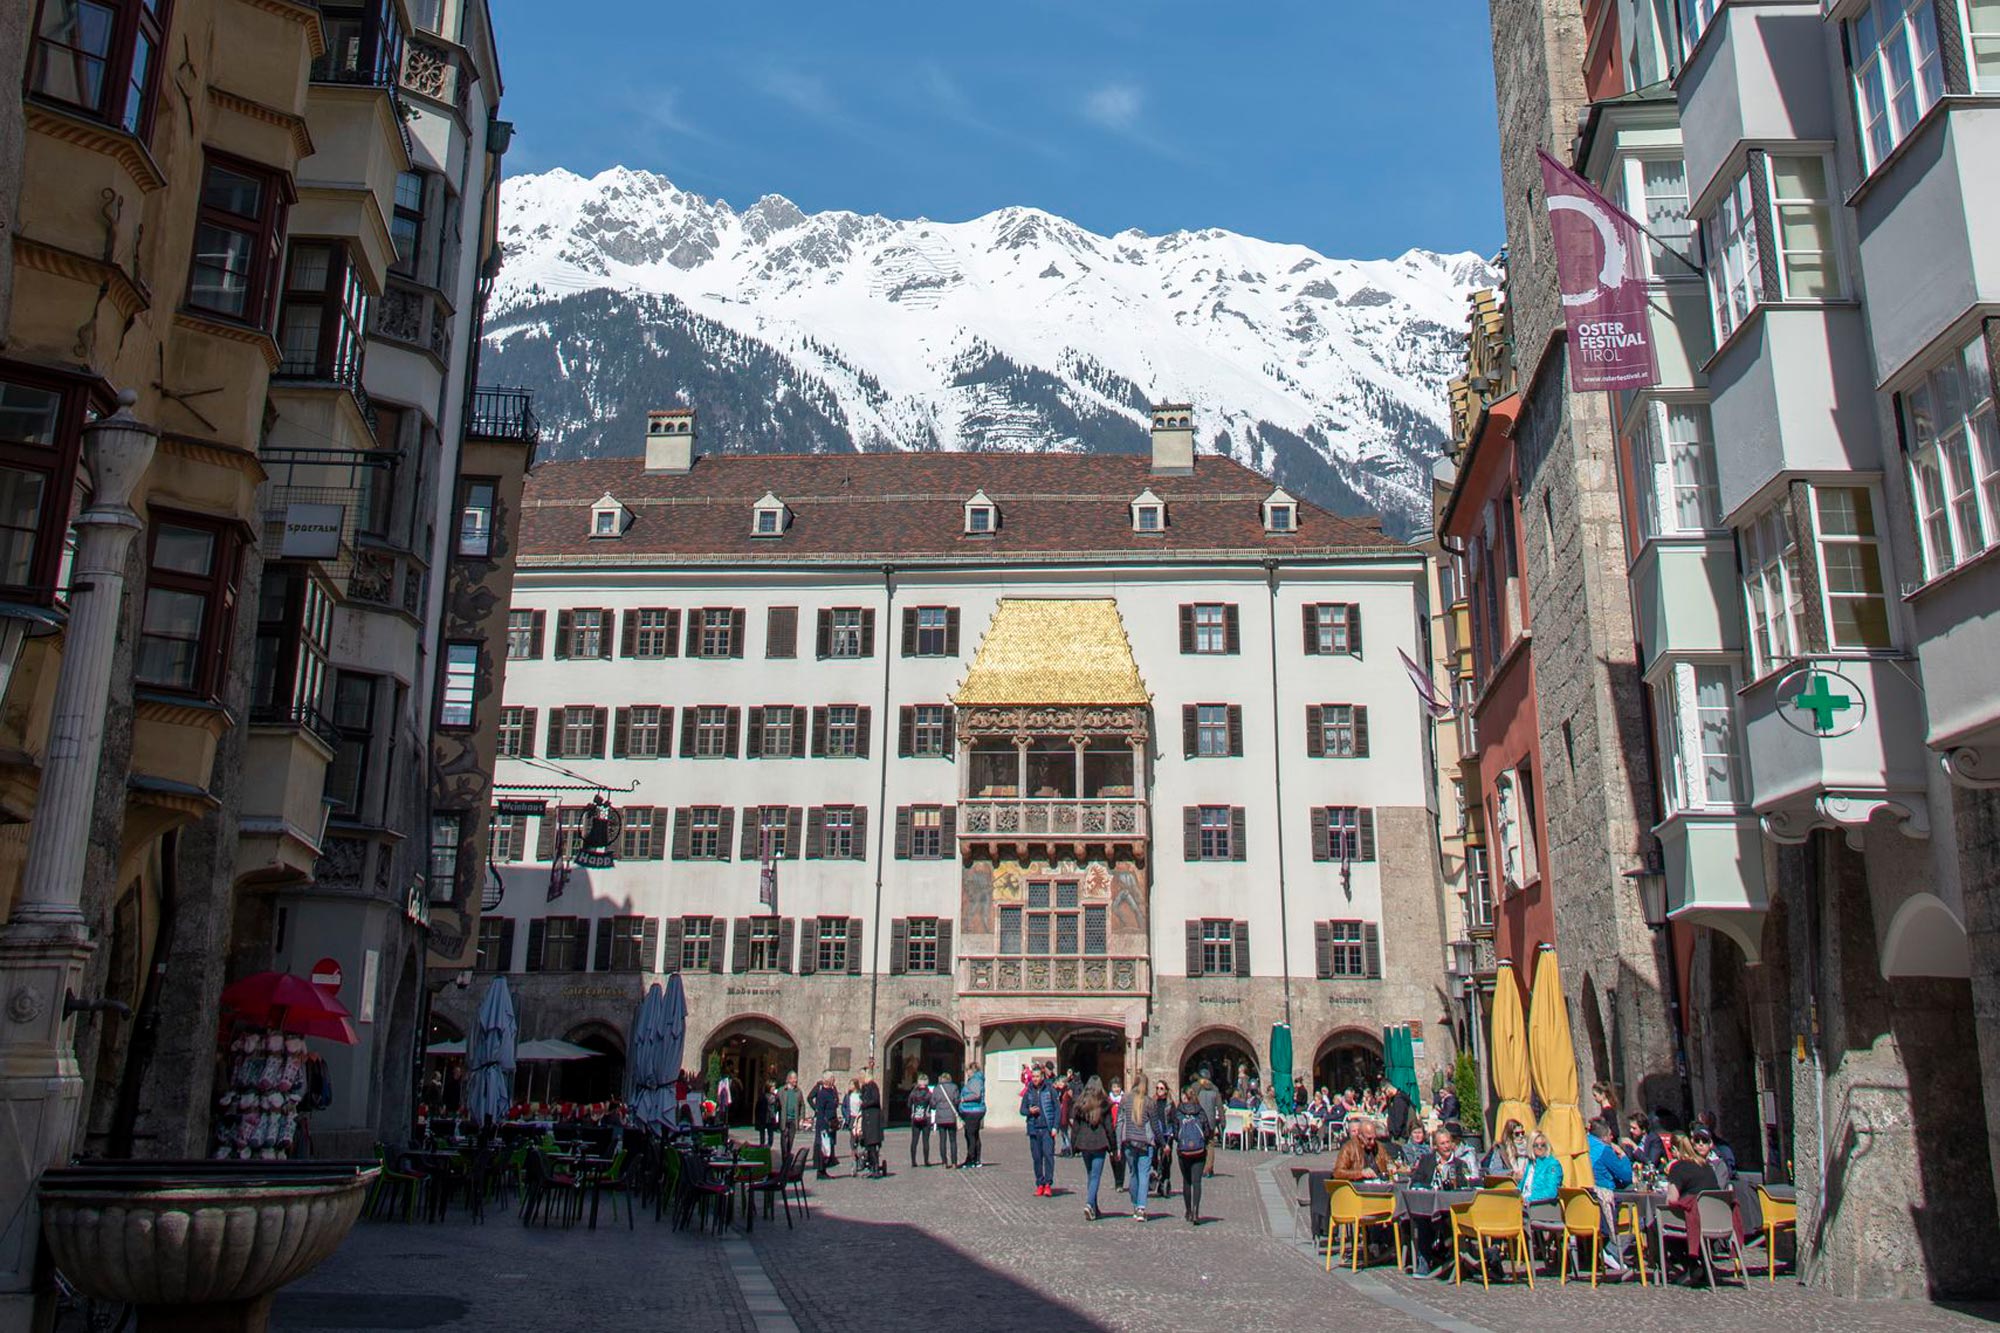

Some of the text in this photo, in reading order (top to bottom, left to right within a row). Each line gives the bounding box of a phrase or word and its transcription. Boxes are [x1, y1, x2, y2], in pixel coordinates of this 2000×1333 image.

[1578, 322, 1625, 336] OSTER
[1579, 332, 1646, 349] FESTIVAL
[1580, 348, 1623, 362] TIROL
[501, 802, 543, 811] Weinhaus
[579, 853, 611, 866] Happ
